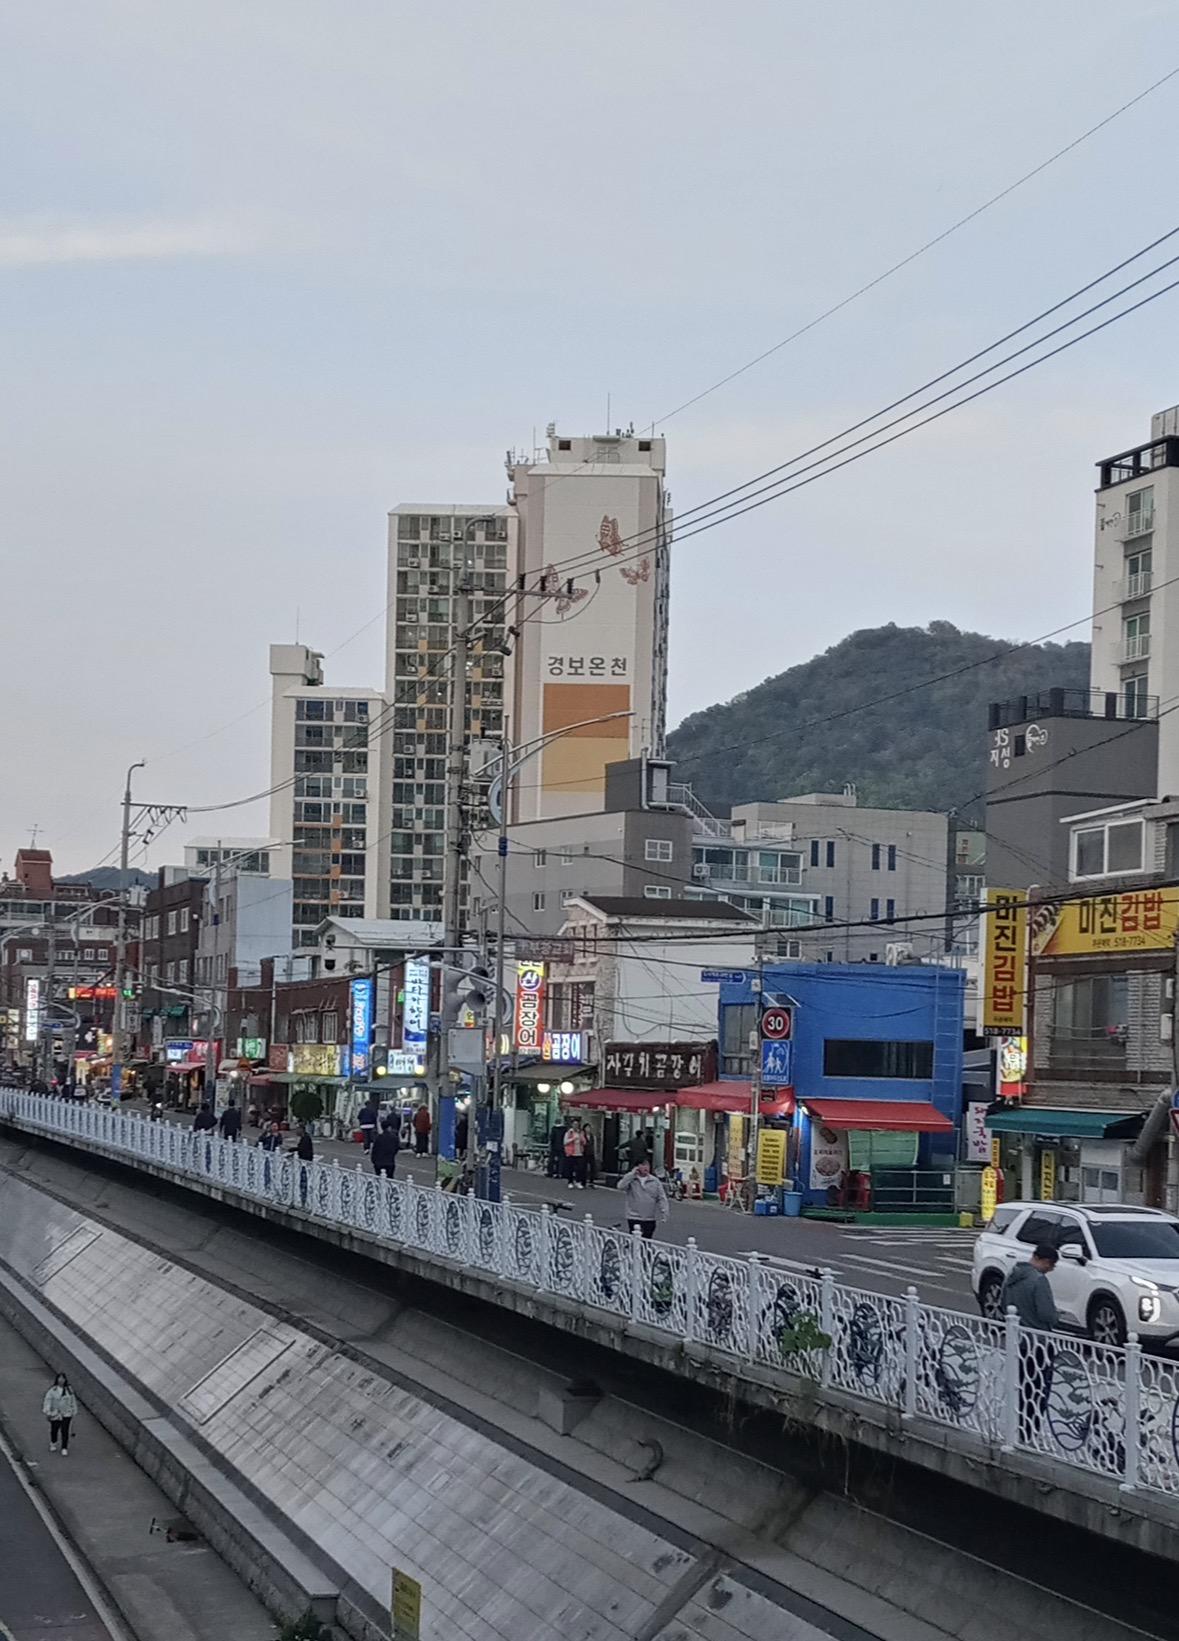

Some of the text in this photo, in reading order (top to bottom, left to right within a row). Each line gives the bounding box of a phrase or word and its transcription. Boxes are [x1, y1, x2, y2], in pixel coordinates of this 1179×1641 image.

[548, 656, 627, 677] 경보온천
[989, 746, 1011, 769] 지성
[1078, 890, 1163, 935] 미진김밥
[992, 894, 1018, 1012] 미진김밥
[767, 1017, 784, 1031] 30
[985, 1026, 1022, 1036] 518-7734
